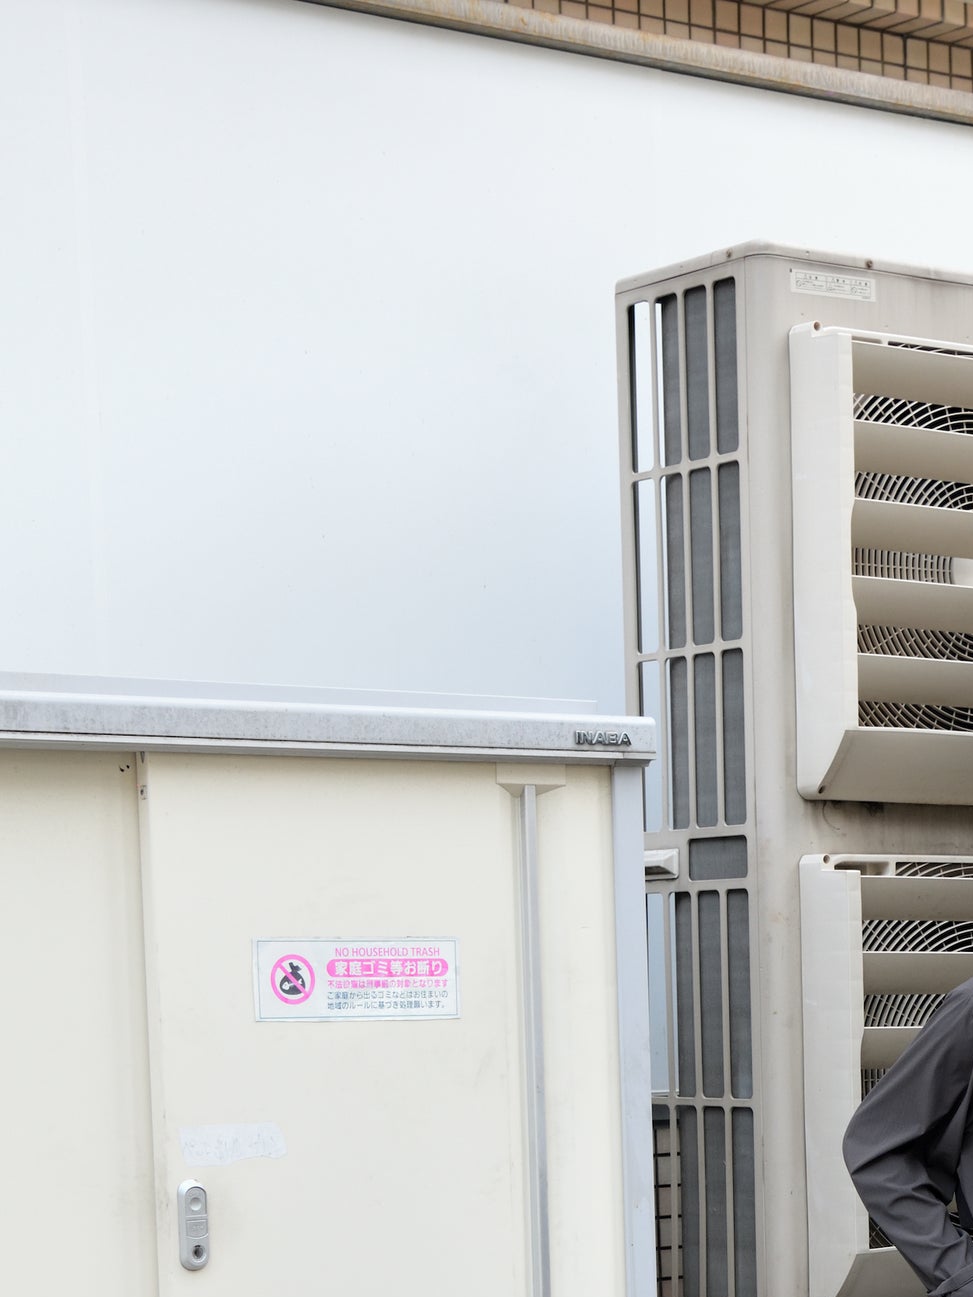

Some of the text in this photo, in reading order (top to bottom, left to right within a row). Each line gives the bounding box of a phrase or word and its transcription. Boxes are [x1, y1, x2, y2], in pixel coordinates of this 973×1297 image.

[575, 730, 632, 746] INABA
[335, 947, 440, 957] NO HOUSEHOLD TRASH
[334, 960, 442, 976] 家庭ゴミ等お断り
